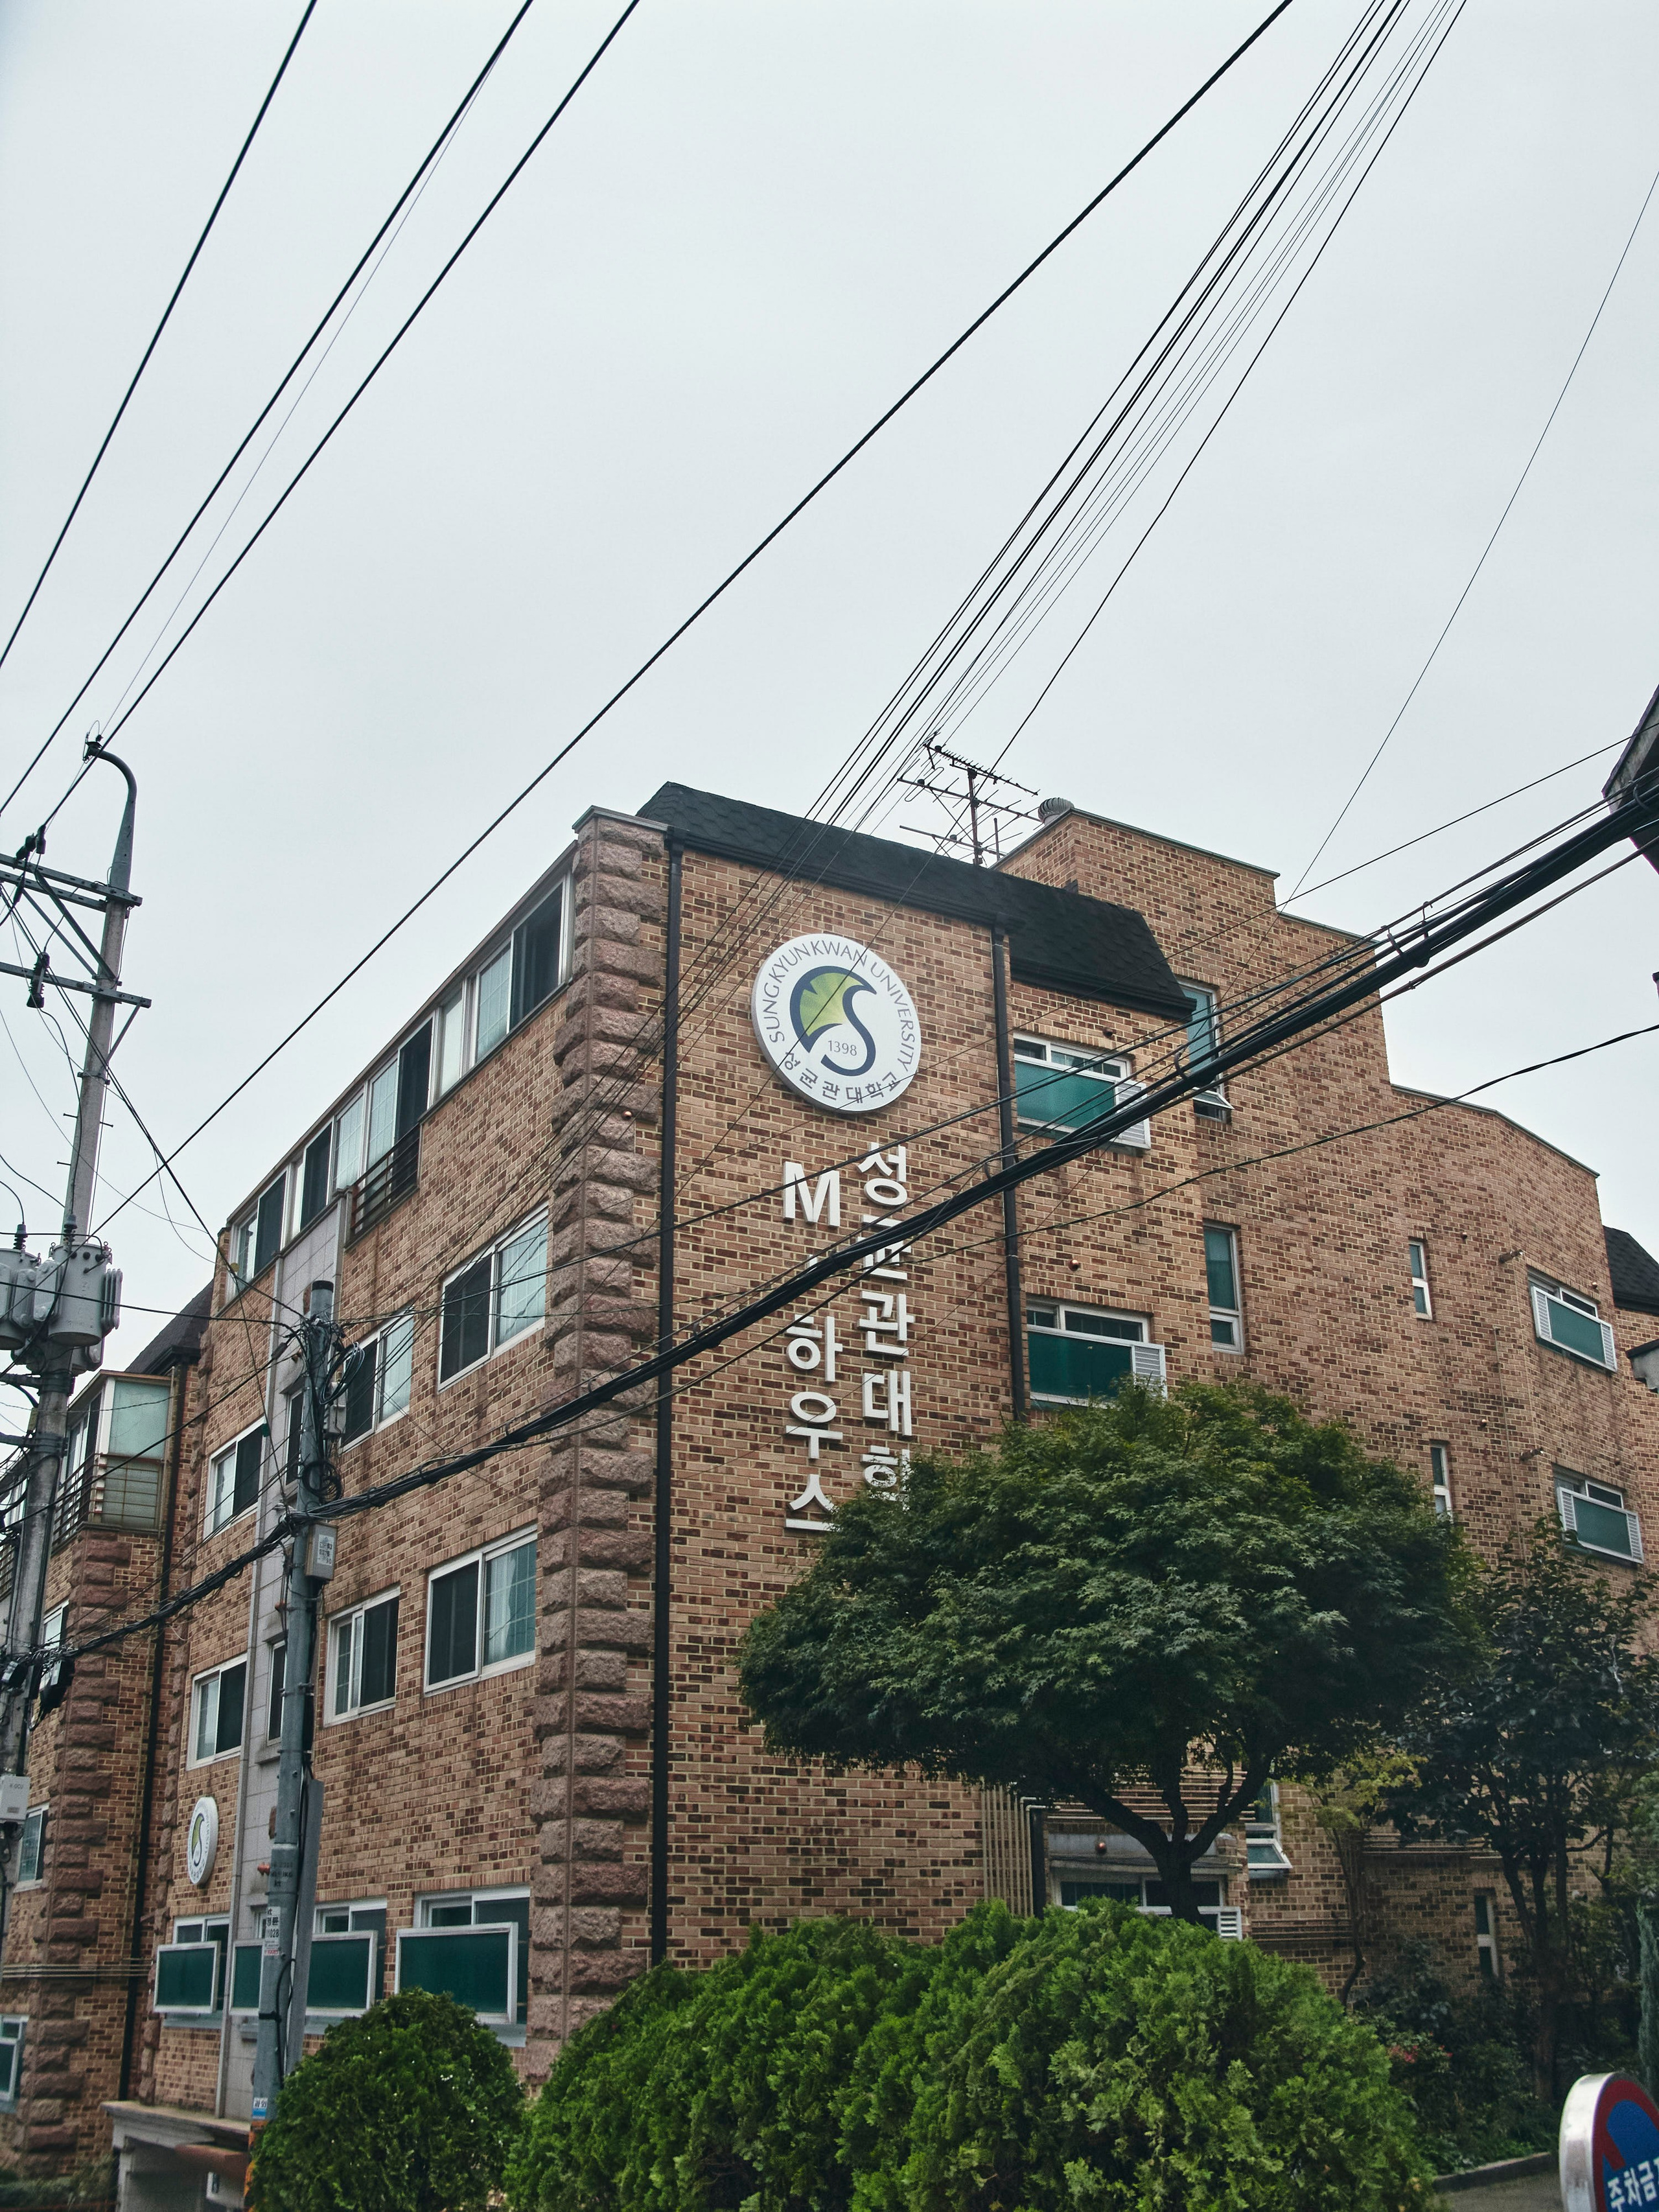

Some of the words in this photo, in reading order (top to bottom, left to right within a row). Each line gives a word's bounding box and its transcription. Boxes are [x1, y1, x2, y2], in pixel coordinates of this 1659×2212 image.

[763, 940, 867, 1042] SUNGKYUNKWAN
[870, 962, 915, 1072] UNIVERSITY
[828, 1040, 857, 1056] 1398
[785, 1052, 900, 1103] 성균관대학교
[1607, 2156, 1659, 2212] 주차금
